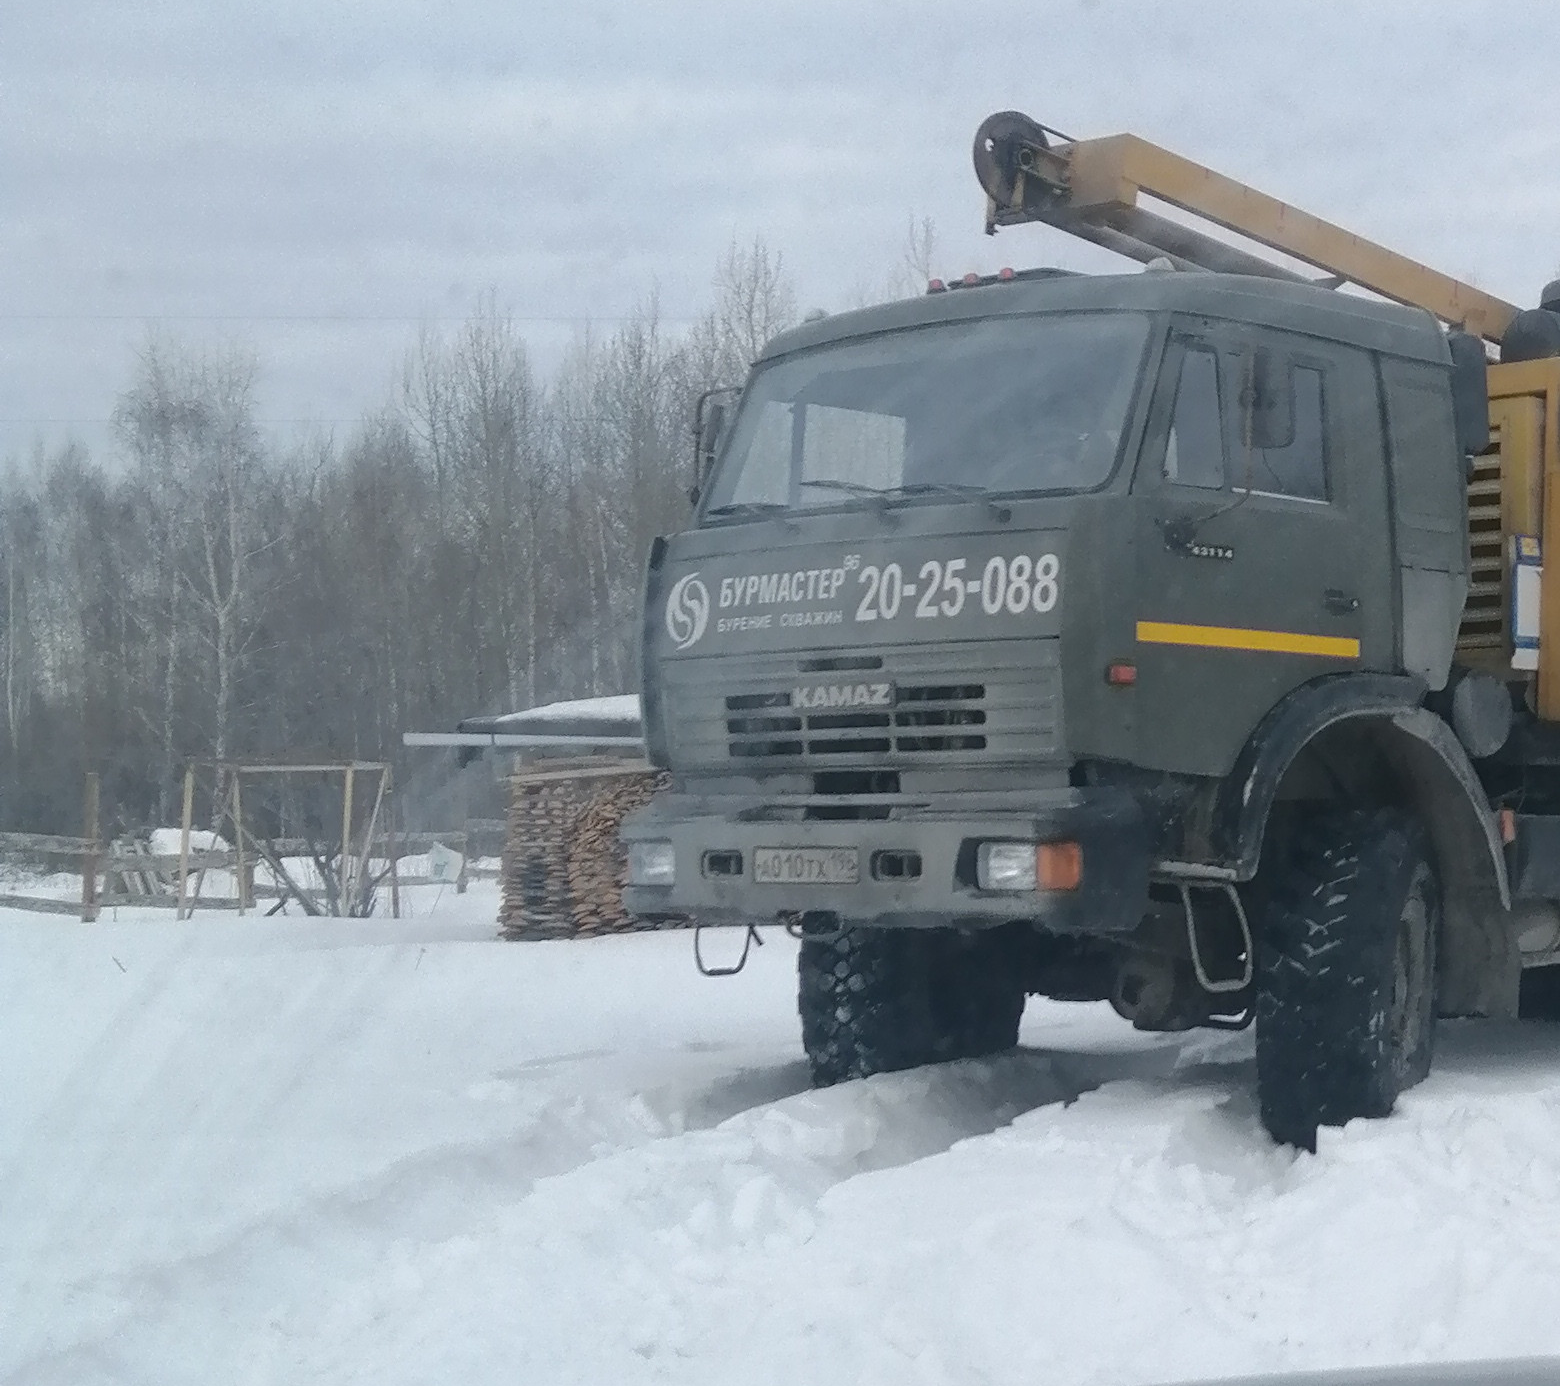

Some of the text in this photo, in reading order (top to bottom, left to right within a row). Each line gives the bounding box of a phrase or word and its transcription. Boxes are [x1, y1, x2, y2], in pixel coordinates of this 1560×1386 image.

[719, 568, 846, 608] БУРМАСТЕР
[855, 553, 1060, 622] 20-25-088
[717, 610, 843, 633] БУРЕНИЕ СКВАЖИН
[792, 683, 891, 708] KAMAZ
